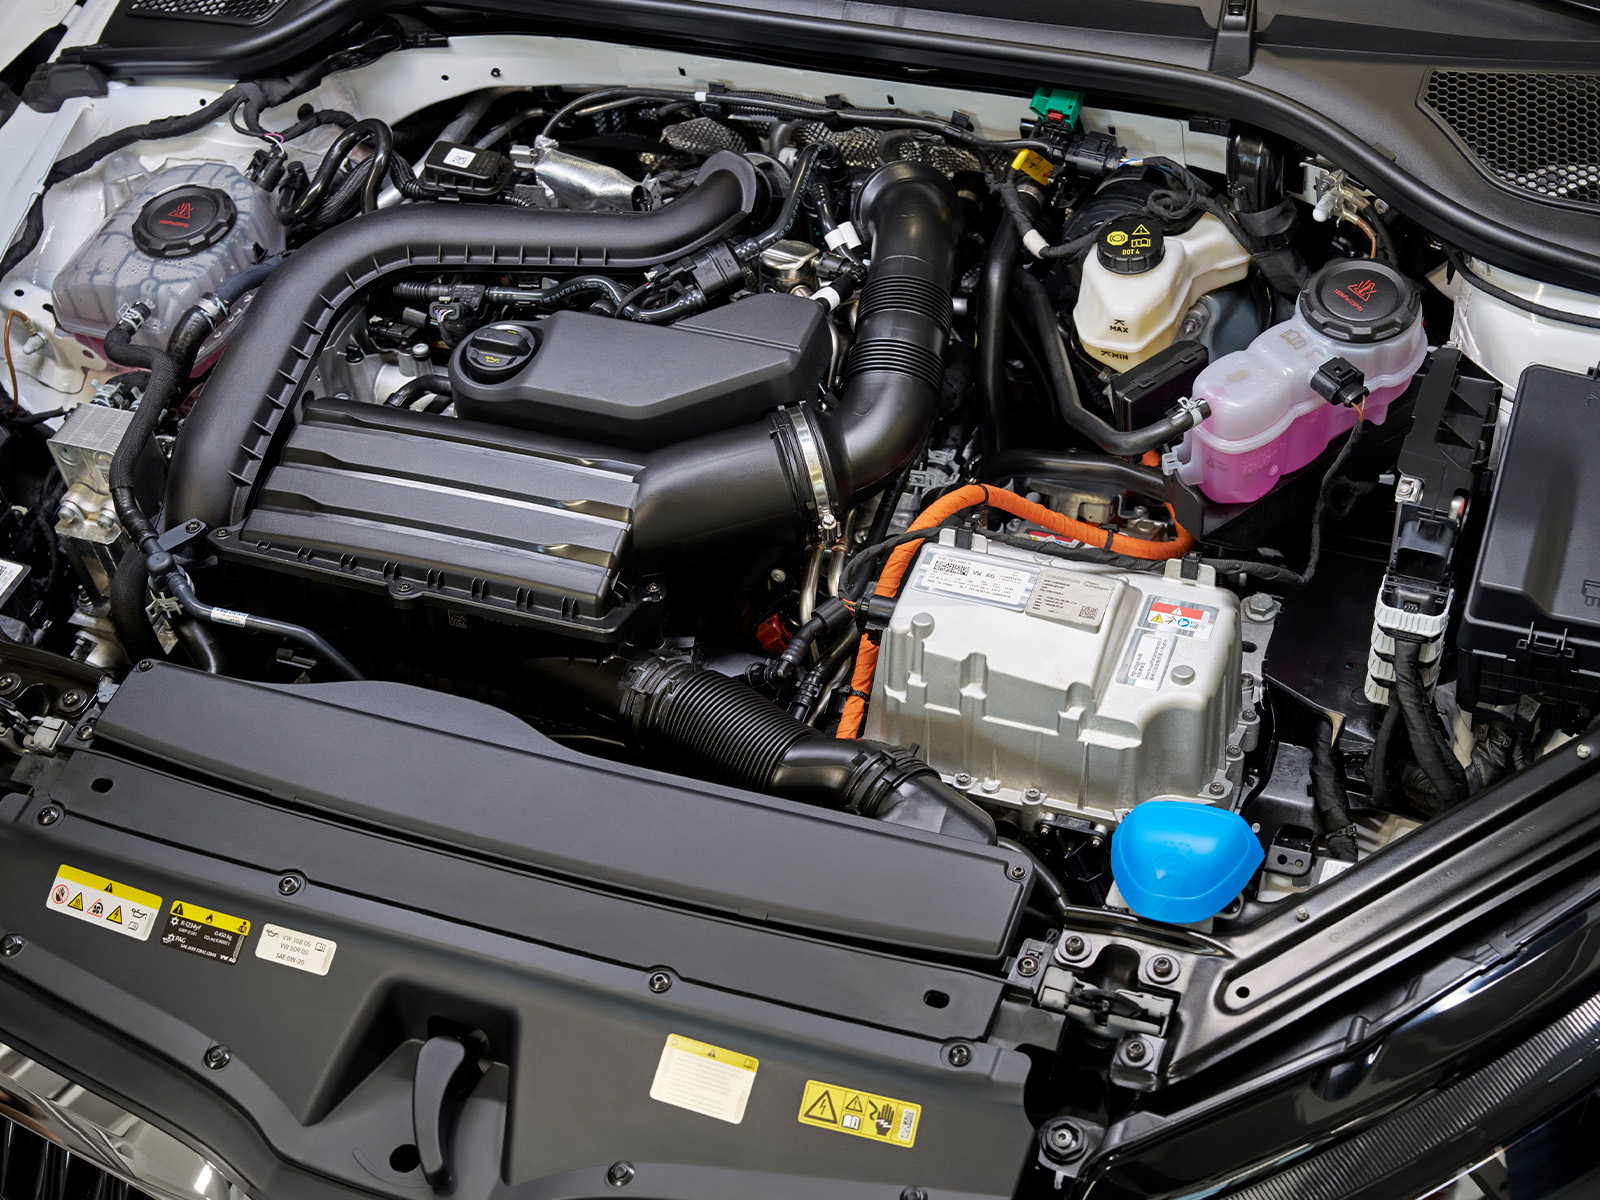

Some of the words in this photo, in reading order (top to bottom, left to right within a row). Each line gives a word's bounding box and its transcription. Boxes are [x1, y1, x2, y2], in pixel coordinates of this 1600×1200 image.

[1109, 325, 1129, 334] MAX
[1112, 352, 1129, 361] MIN
[174, 935, 187, 944] PAG
[282, 934, 293, 942] VW
[292, 937, 304, 946] 508
[303, 940, 312, 948] 00
[280, 942, 290, 951] VW
[289, 945, 301, 954] 509
[300, 948, 309, 956] 00
[220, 954, 229, 962] VW
[276, 952, 286, 960] SAE
[286, 955, 305, 966] 0W-20
